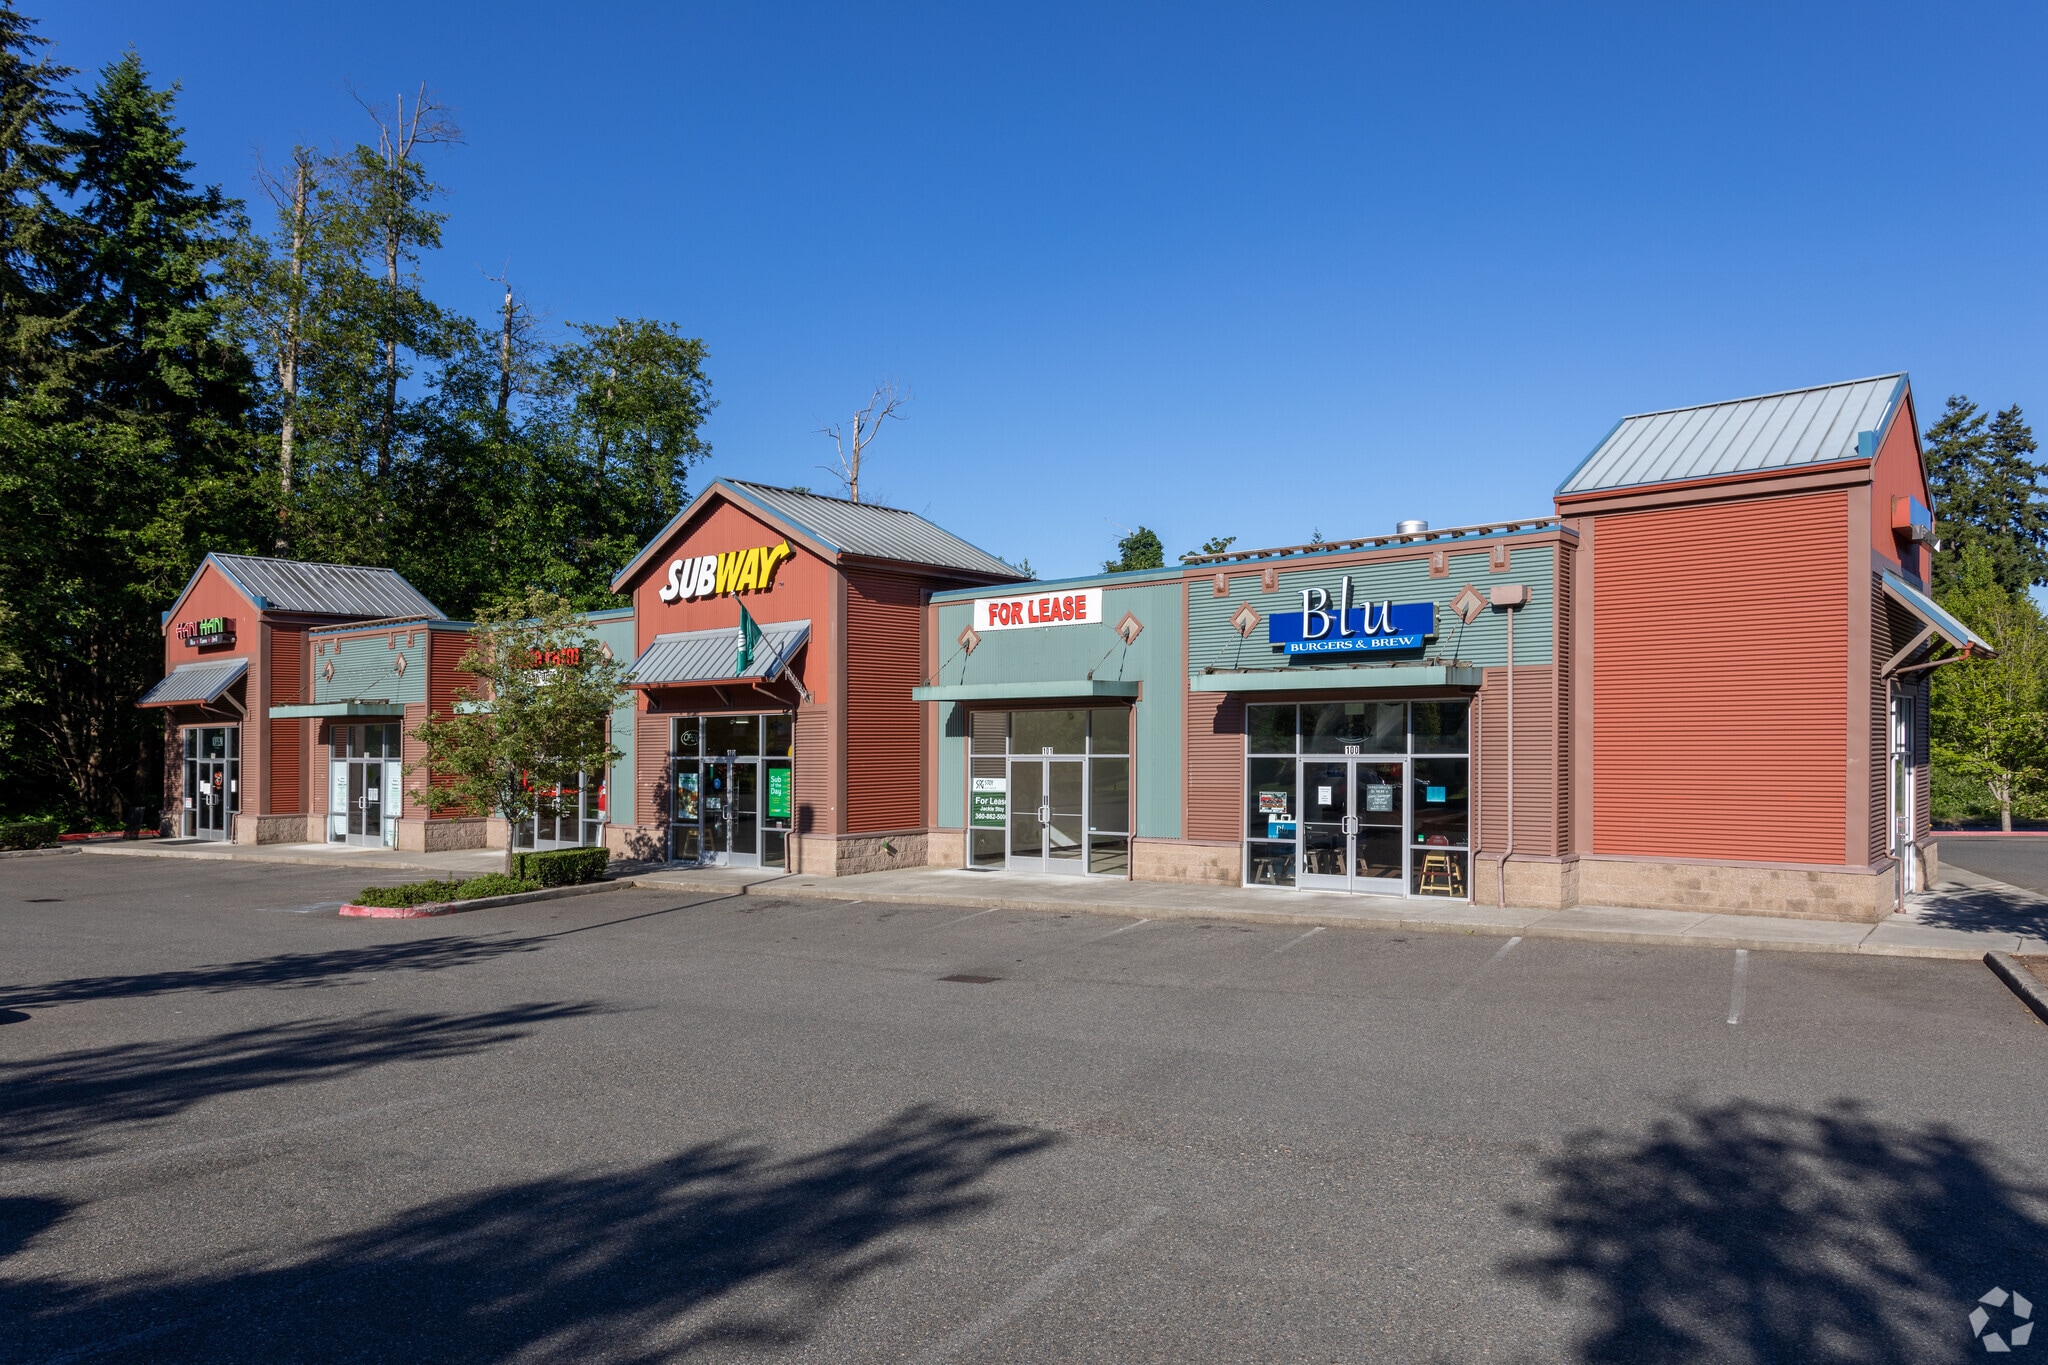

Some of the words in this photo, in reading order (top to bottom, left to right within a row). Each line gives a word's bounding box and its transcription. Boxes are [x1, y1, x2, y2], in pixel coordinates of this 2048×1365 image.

[659, 539, 790, 602] SUBWAY
[989, 602, 1023, 626] FOR
[1028, 595, 1086, 624] LEASE
[1298, 576, 1400, 638] Blu
[1291, 640, 1352, 652] BURGERS
[1355, 640, 1368, 648] &
[1371, 636, 1414, 647] BREW
[1043, 746, 1053, 754] 101
[1345, 746, 1359, 754] 100
[770, 775, 781, 783] Sub
[770, 788, 781, 796] Day
